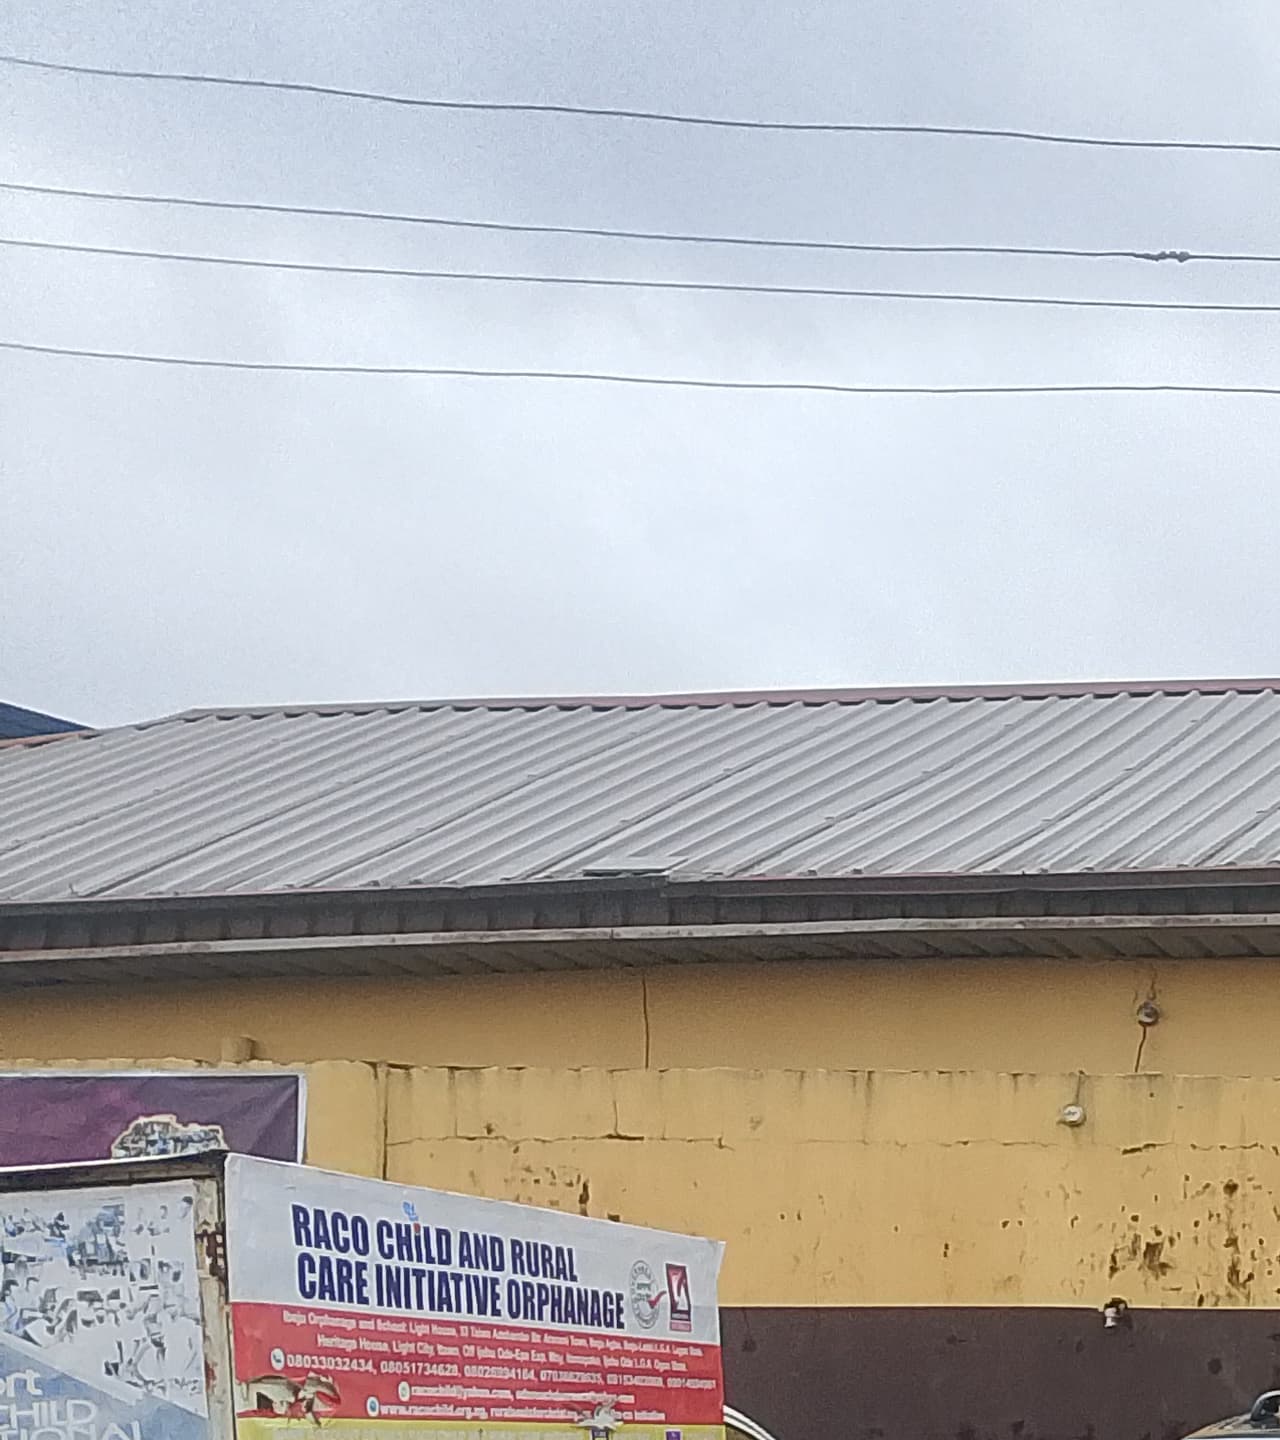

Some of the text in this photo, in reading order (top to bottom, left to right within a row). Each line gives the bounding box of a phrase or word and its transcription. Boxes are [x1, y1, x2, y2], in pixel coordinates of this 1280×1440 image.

[292, 1204, 369, 1255] RACO
[458, 1231, 506, 1273] AND
[510, 1238, 578, 1283] RURAL
[297, 1252, 370, 1306] CARE
[375, 1262, 502, 1317] INITIATIVE
[506, 1279, 625, 1330] ORPHANAGE
